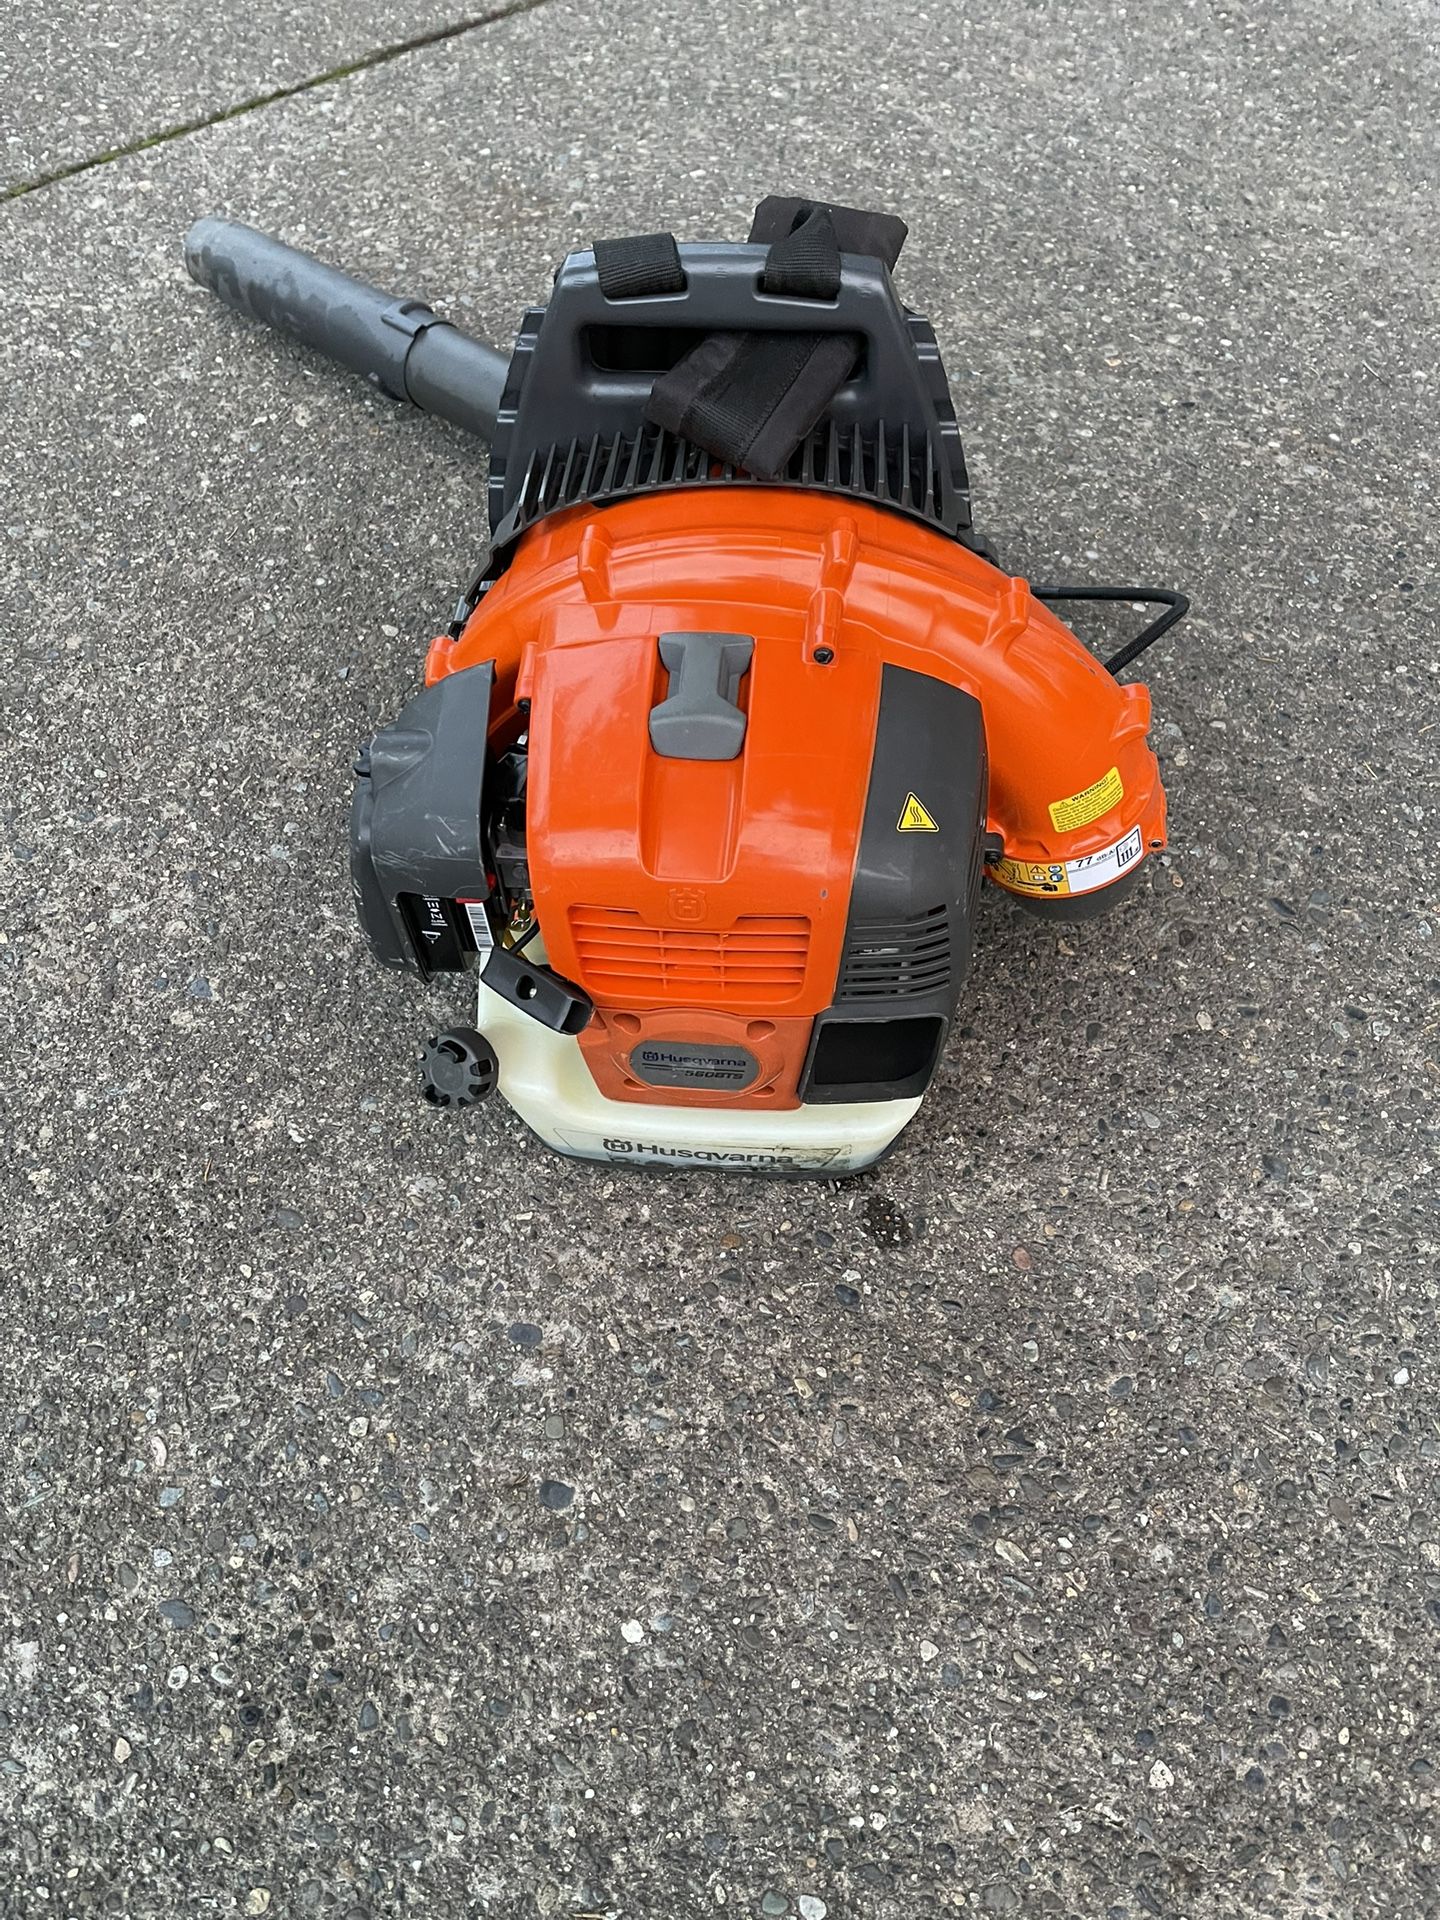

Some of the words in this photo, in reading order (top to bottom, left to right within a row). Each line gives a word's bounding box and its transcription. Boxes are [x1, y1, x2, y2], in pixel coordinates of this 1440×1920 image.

[1071, 776, 1109, 802] WARNING!
[1076, 856, 1093, 868] 77
[661, 1053, 747, 1067] Husqvarna
[637, 1142, 793, 1164] Husqvarna
